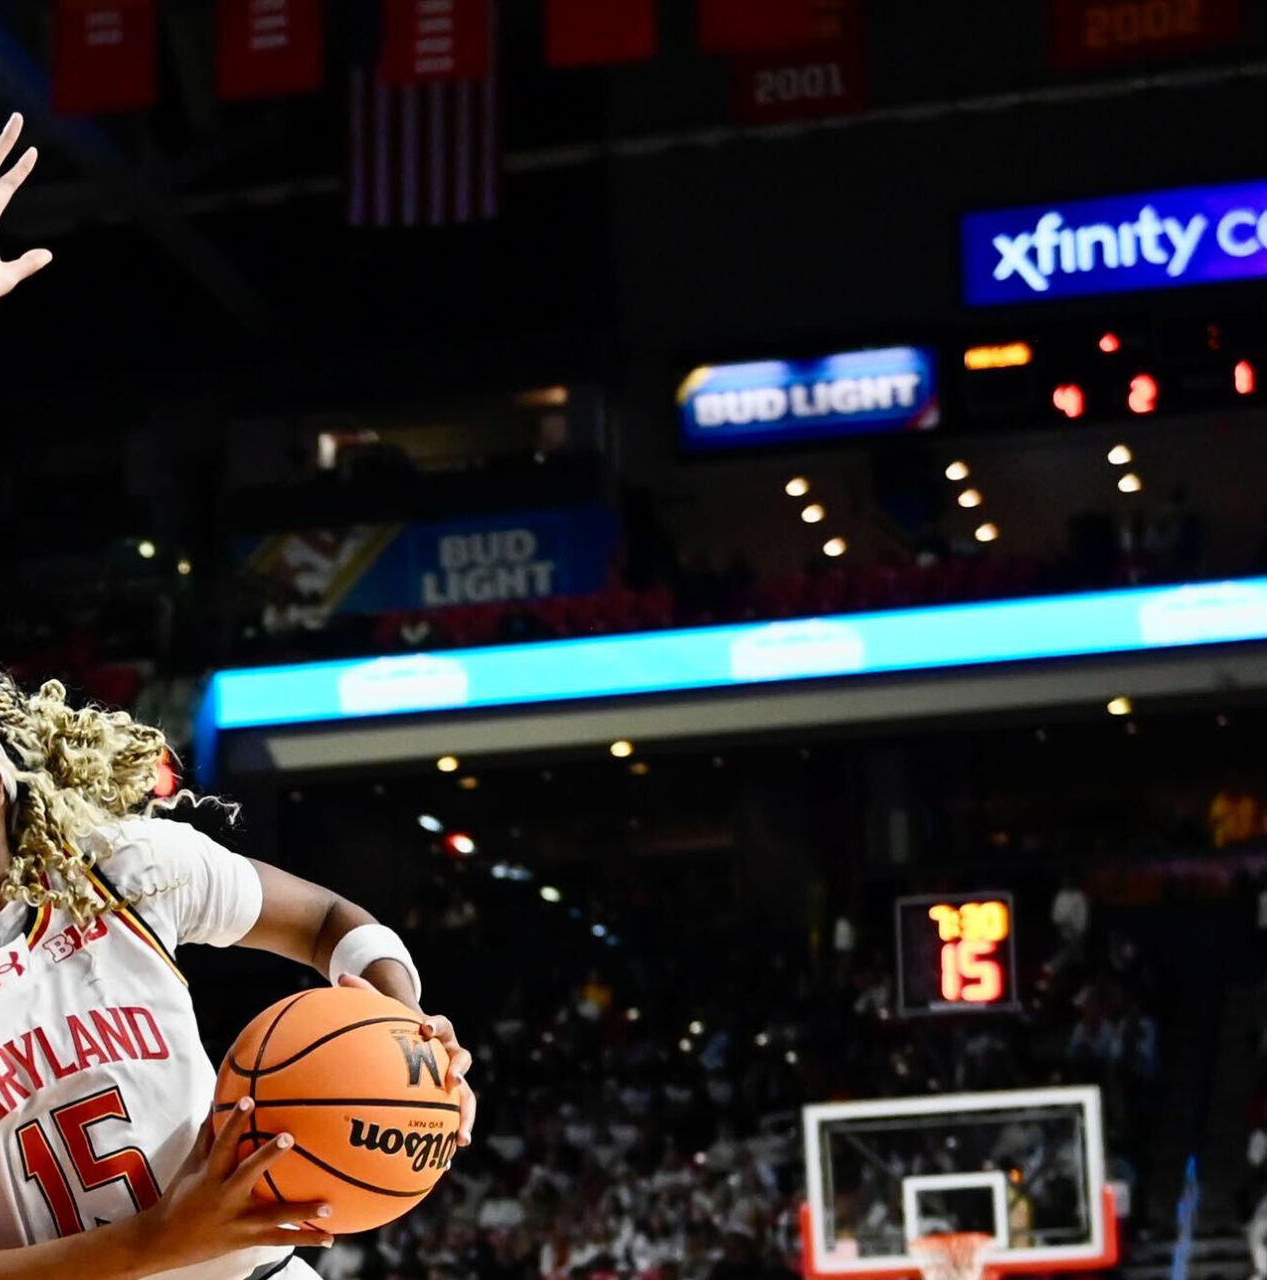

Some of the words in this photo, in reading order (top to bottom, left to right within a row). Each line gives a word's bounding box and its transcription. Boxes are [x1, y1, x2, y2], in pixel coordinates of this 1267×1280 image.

[992, 204, 1207, 291] xfinity
[1216, 207, 1267, 256] c
[693, 386, 788, 427] BUD
[788, 374, 919, 416] LIGHT
[438, 529, 536, 569] BUD
[422, 562, 554, 605] LIGHT
[941, 941, 1002, 1001] 15
[16, 1085, 163, 1238] 15
